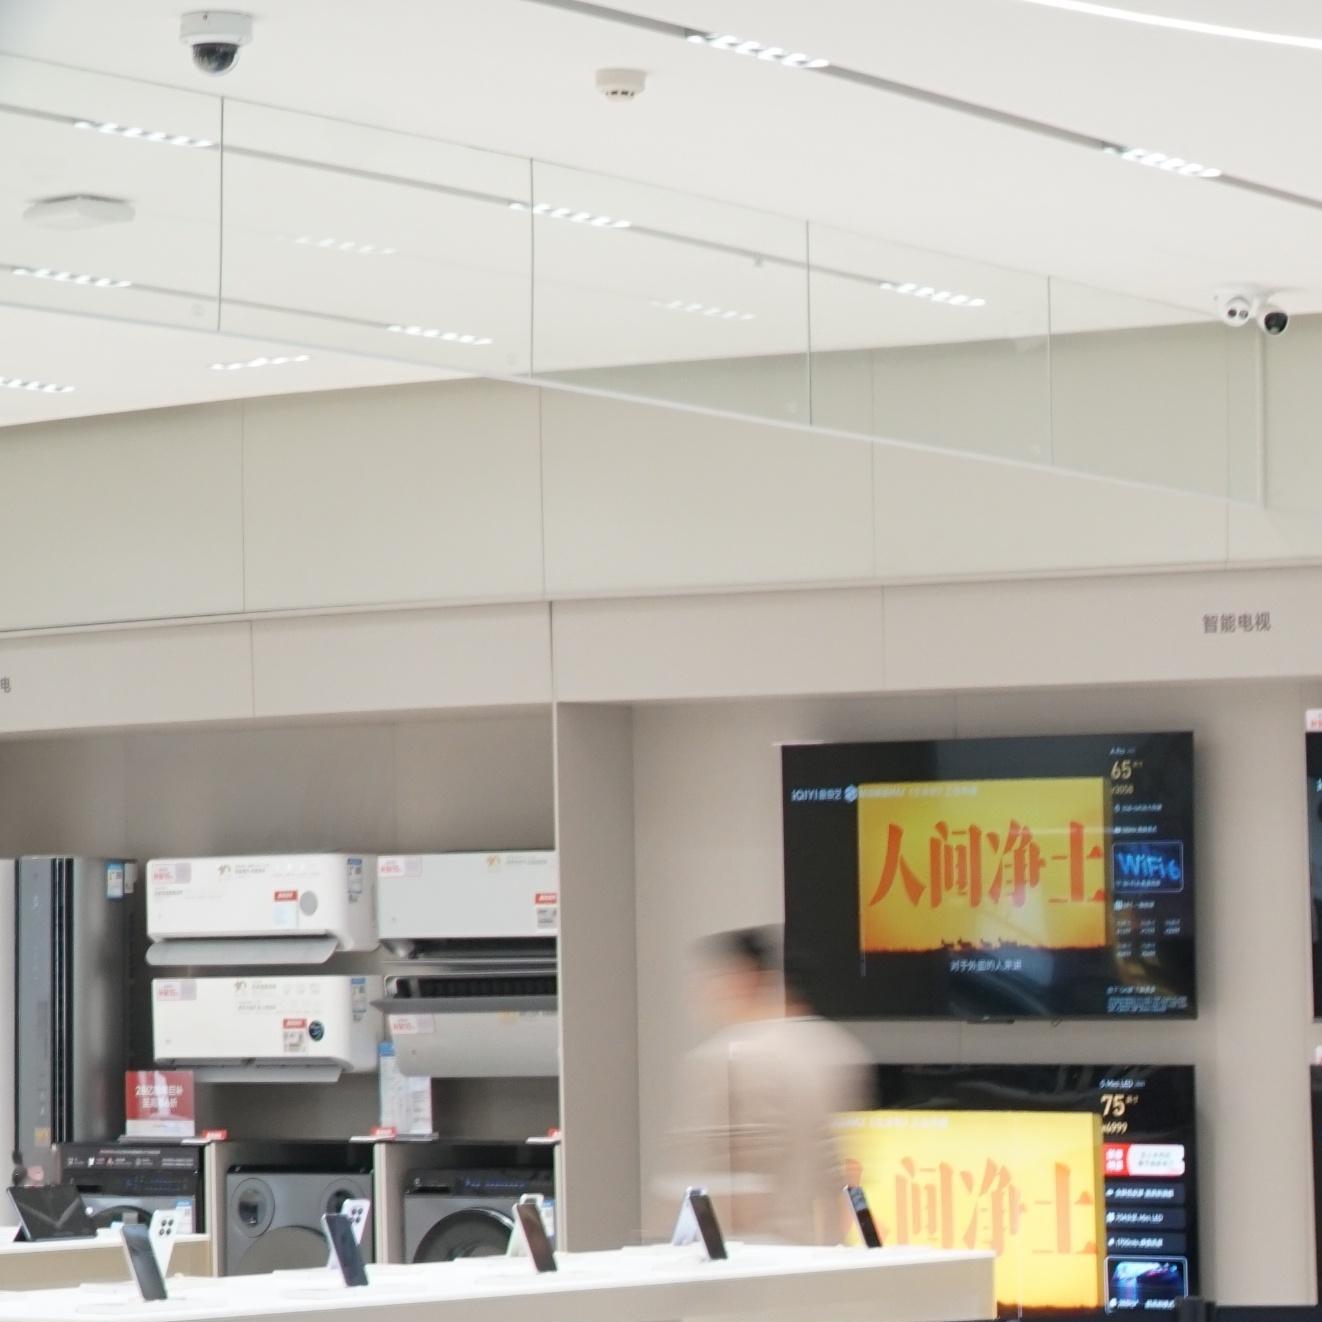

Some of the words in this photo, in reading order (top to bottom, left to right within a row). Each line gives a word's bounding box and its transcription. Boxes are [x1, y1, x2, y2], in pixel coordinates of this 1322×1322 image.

[1202, 613, 1272, 634] 智能电视
[867, 818, 1106, 909] 人间净土
[1101, 1093, 1125, 1117] 75
